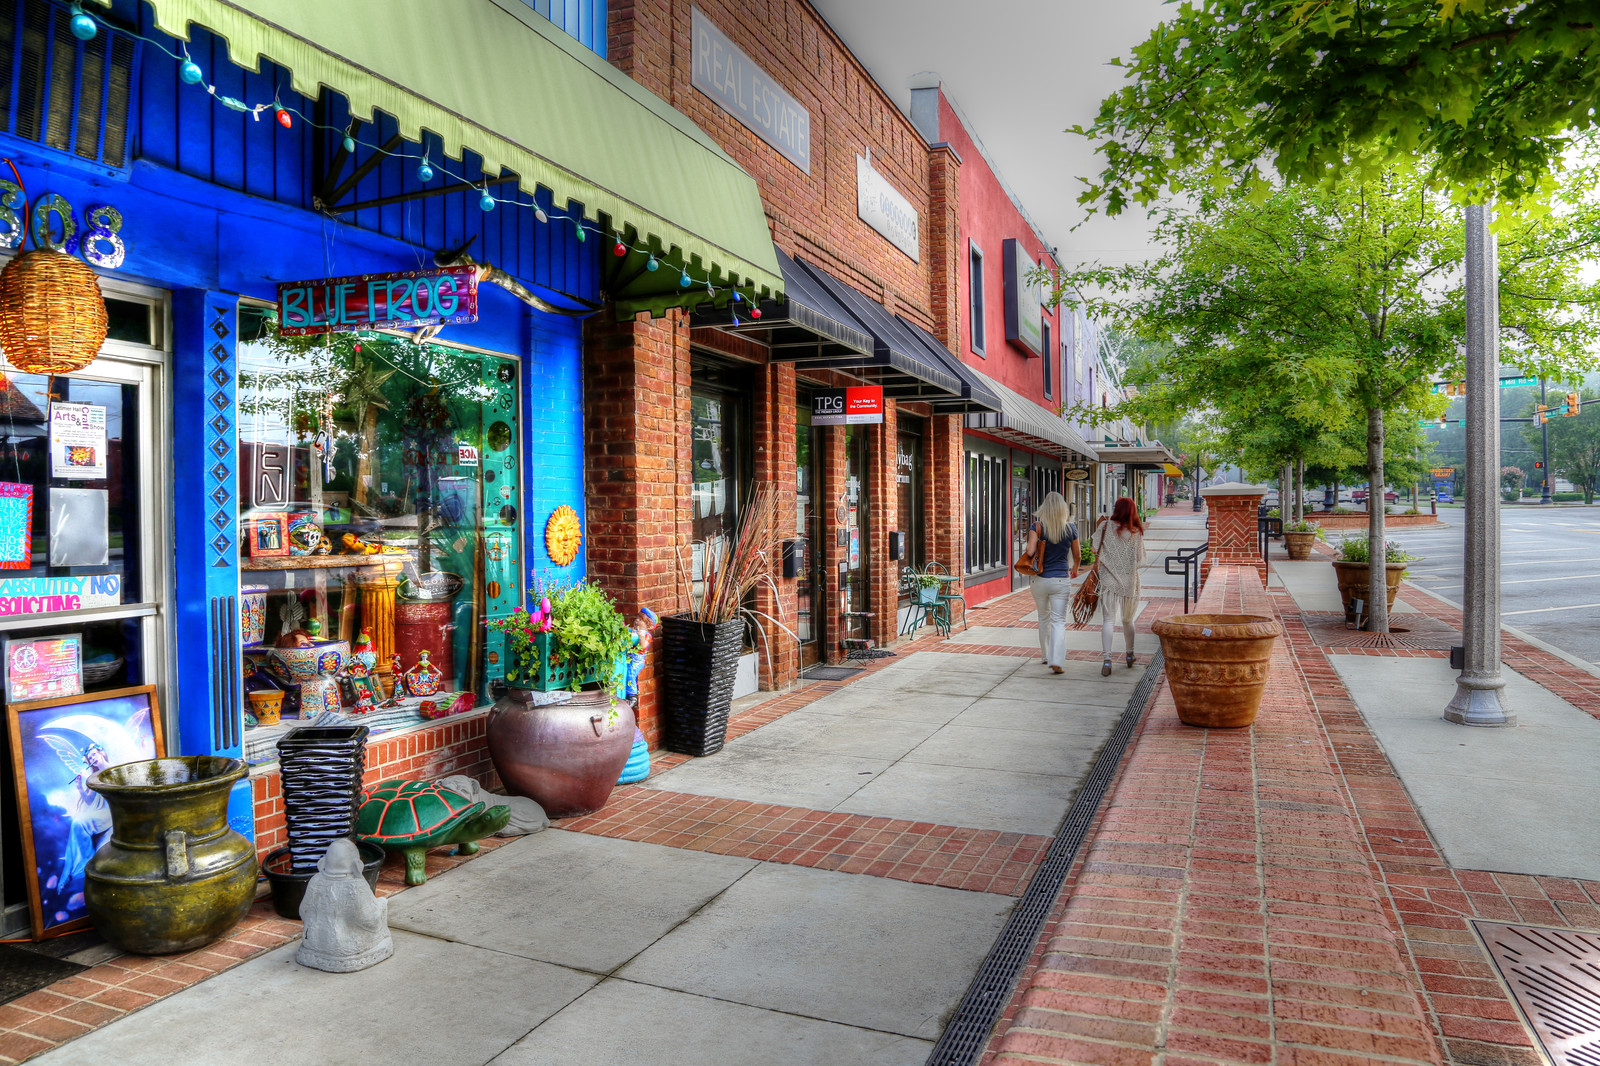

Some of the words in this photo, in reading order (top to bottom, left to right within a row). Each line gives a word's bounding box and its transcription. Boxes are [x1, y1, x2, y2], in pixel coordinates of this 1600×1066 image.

[699, 27, 748, 111] REAL
[752, 75, 806, 158] ESTATE
[282, 283, 358, 328] BLUE
[367, 275, 459, 322] FROG
[815, 396, 843, 409] TPG
[54, 411, 77, 422] Arts
[76, 418, 81, 426] &
[260, 376, 286, 502] OPEN
[91, 575, 120, 596] NO
[0, 595, 81, 616] SOLICITING
